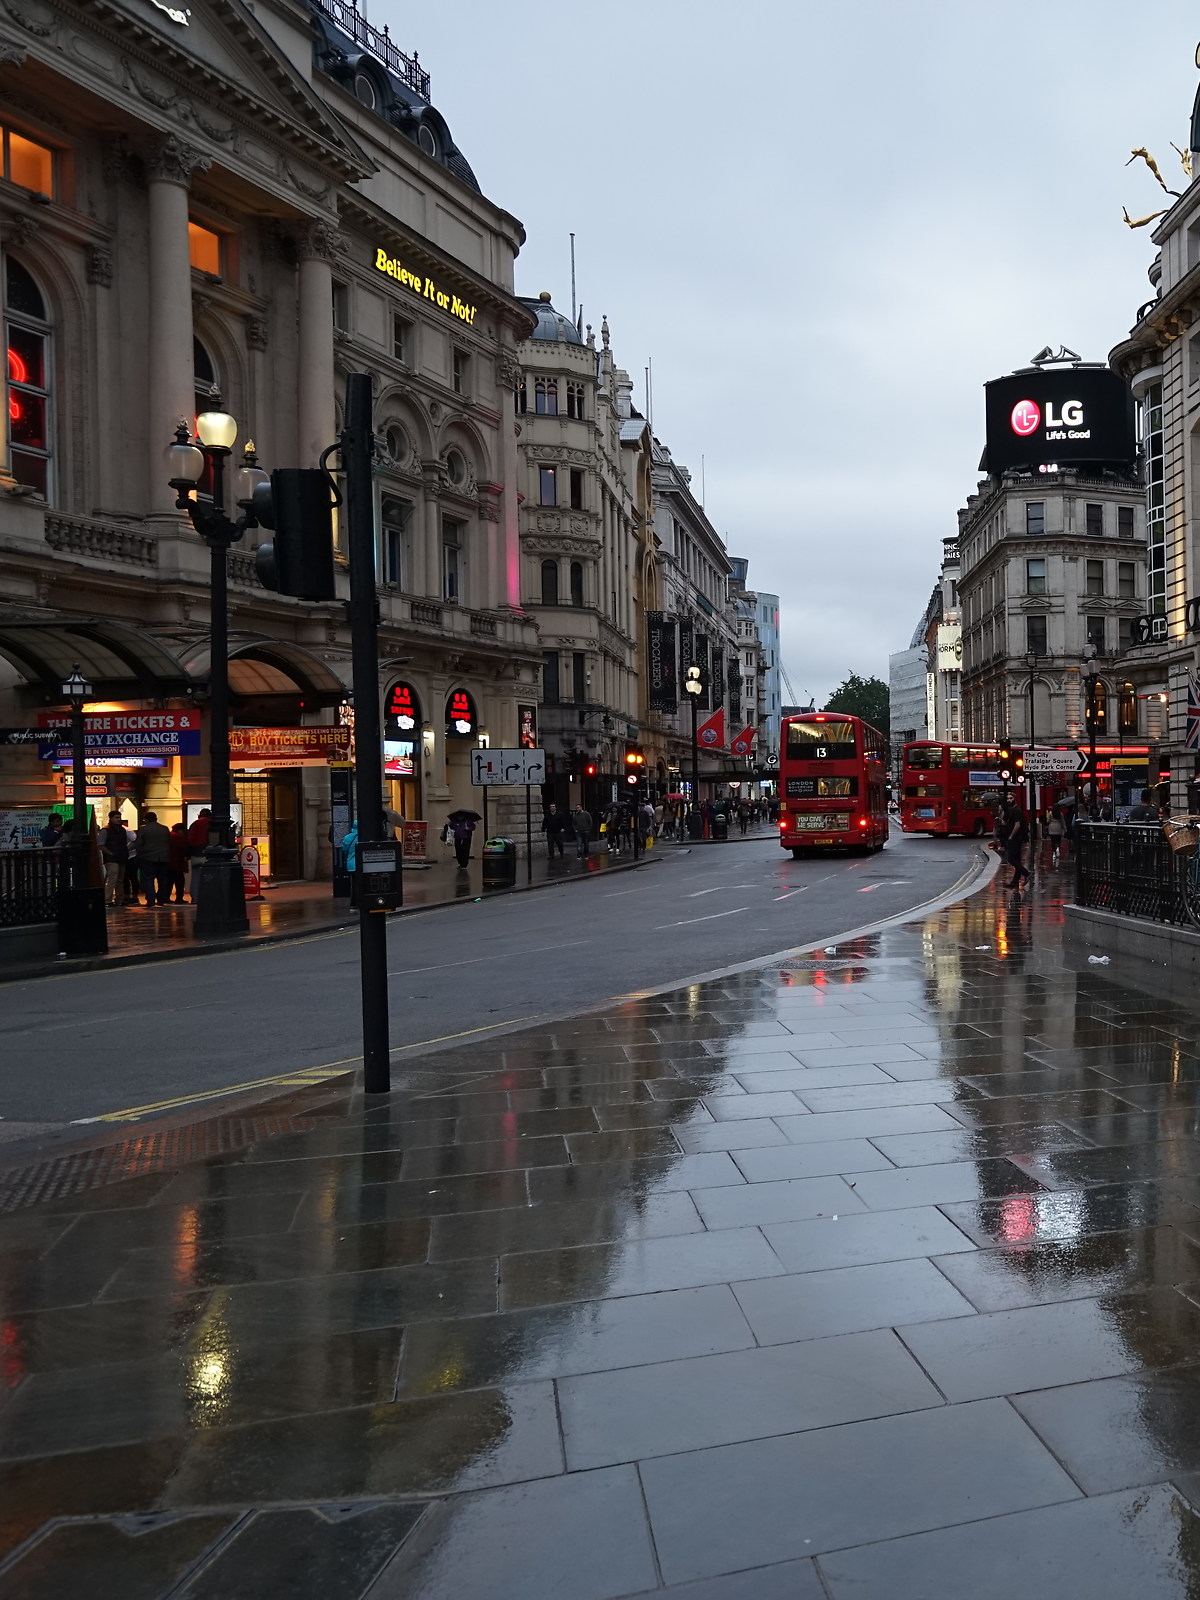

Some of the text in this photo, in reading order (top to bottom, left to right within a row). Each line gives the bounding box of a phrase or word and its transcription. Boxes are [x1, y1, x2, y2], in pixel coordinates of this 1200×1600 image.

[375, 248, 475, 325] Believe It or Not!
[1045, 400, 1084, 427] LG
[1046, 430, 1091, 441] Life's Good
[651, 629, 661, 689] TROCADERO
[47, 716, 190, 730] THETRE TICKETS &
[106, 732, 179, 745] EXCHANGE
[250, 735, 270, 746] BUY
[275, 734, 317, 745] TICKETS
[320, 733, 348, 743] HERE
[816, 747, 827, 758] 13
[96, 758, 143, 767] COMMISSION
[1096, 761, 1111, 770] ABE
